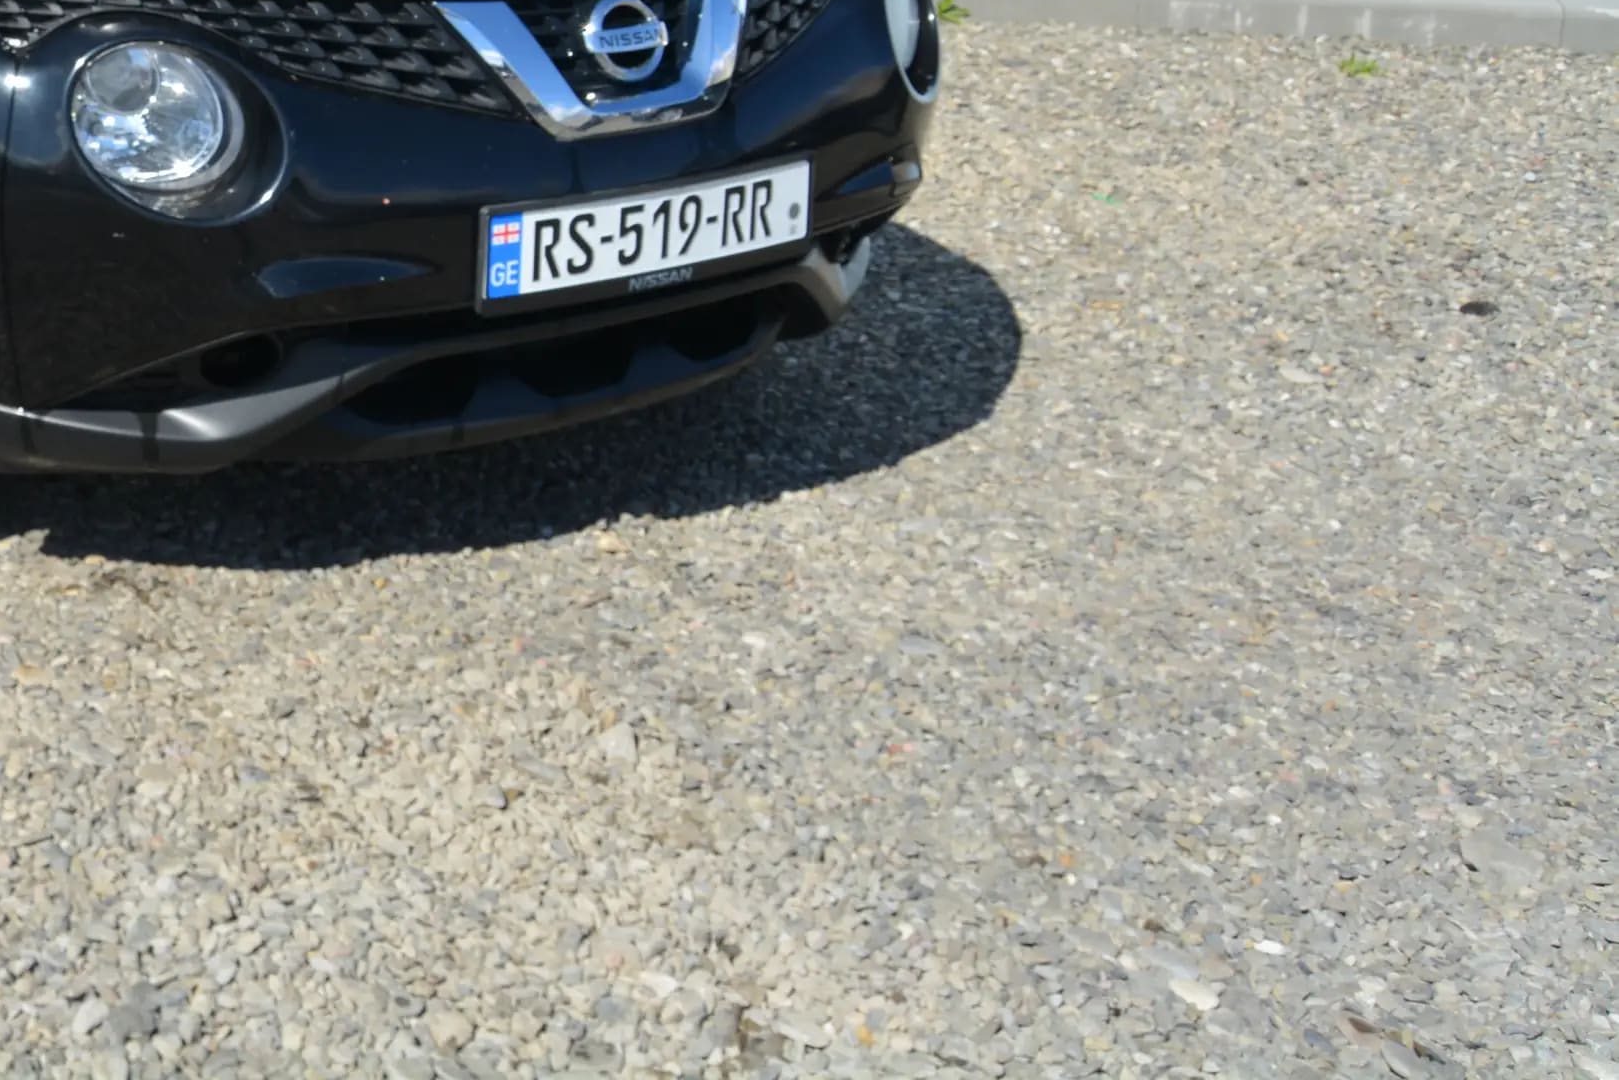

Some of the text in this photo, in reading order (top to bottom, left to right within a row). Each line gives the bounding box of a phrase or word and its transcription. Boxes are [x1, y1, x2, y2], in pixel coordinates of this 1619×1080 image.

[490, 179, 773, 286] GE RS-519-RR
[629, 267, 694, 292] NISSAN
